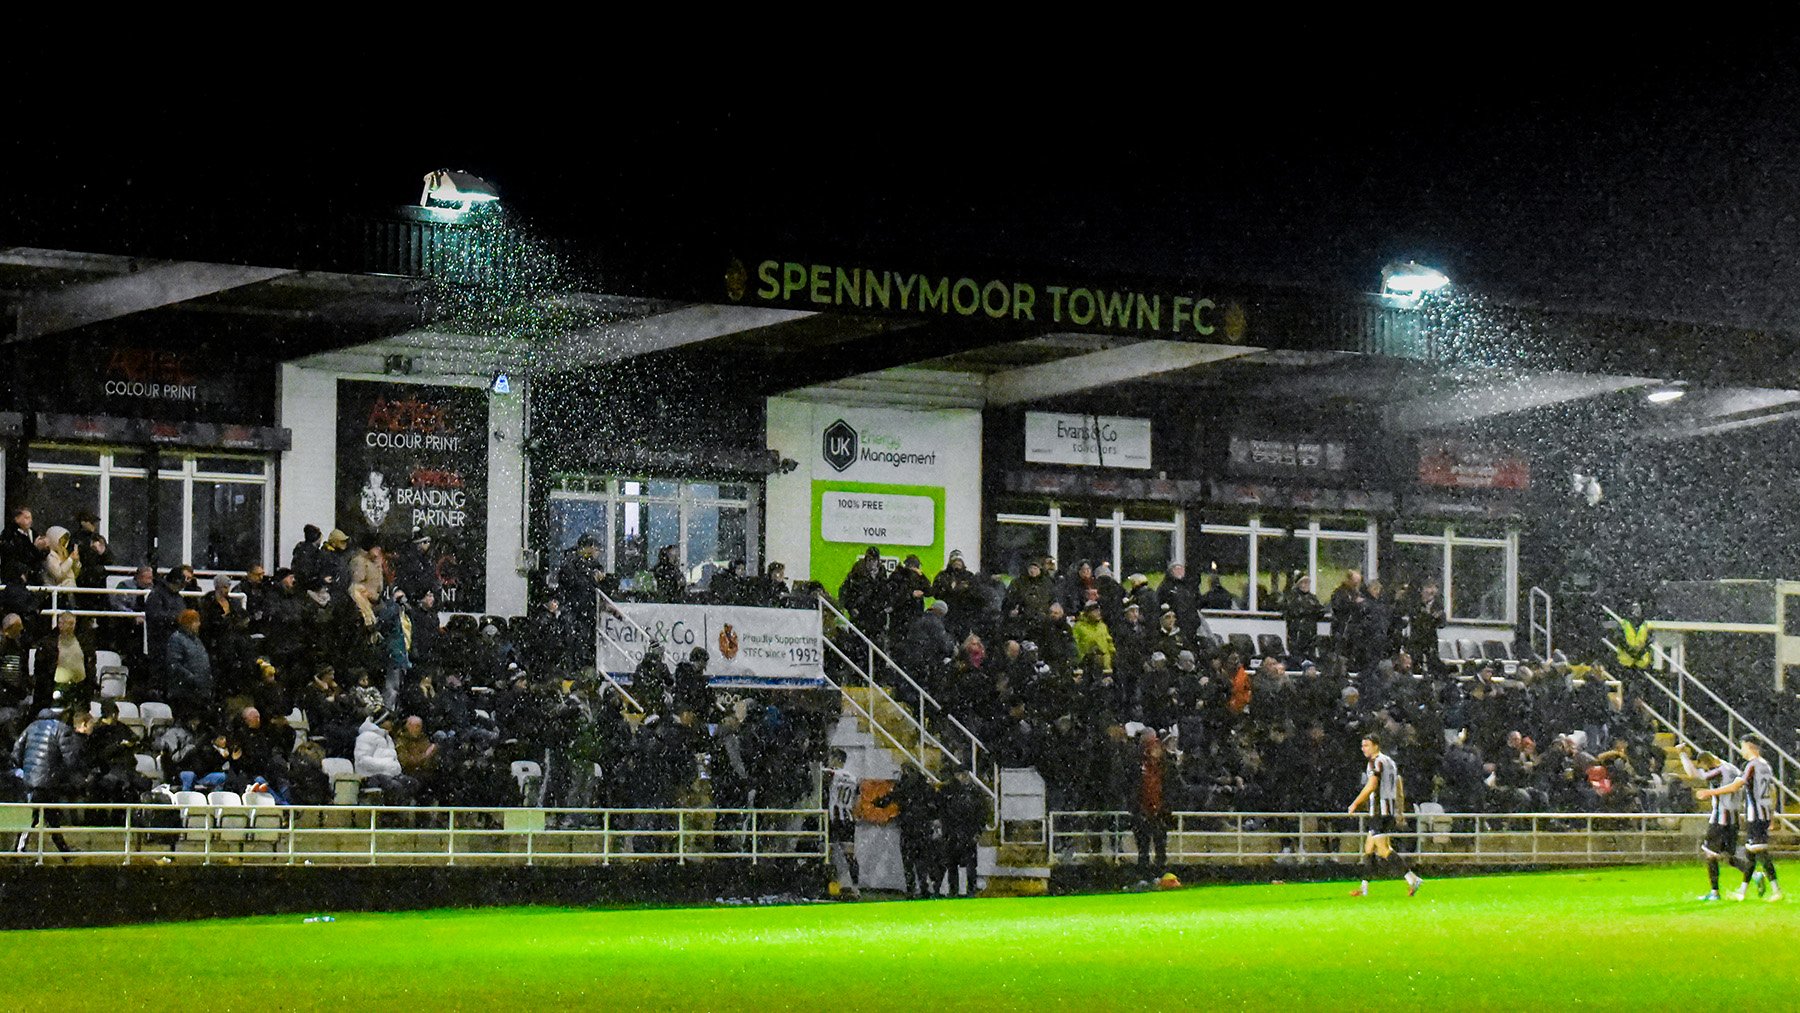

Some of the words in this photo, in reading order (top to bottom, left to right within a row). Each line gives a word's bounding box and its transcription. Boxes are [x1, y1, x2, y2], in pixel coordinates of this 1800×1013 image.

[757, 260, 1035, 321] SPENNYMOOR
[1046, 285, 1160, 331] TOWN
[1172, 296, 1216, 335] FC
[104, 380, 160, 398] COLOUR
[163, 384, 197, 400] PRINT
[365, 432, 422, 450] COLOUR
[424, 434, 460, 452] PRINT
[830, 437, 851, 456] UK
[860, 447, 937, 467] Management
[397, 488, 466, 507] BRANDING
[838, 499, 860, 509] 100%
[862, 501, 884, 510] FREE
[412, 508, 466, 527] PARTNER
[863, 527, 887, 537] YOUR
[789, 648, 818, 663] 1992
